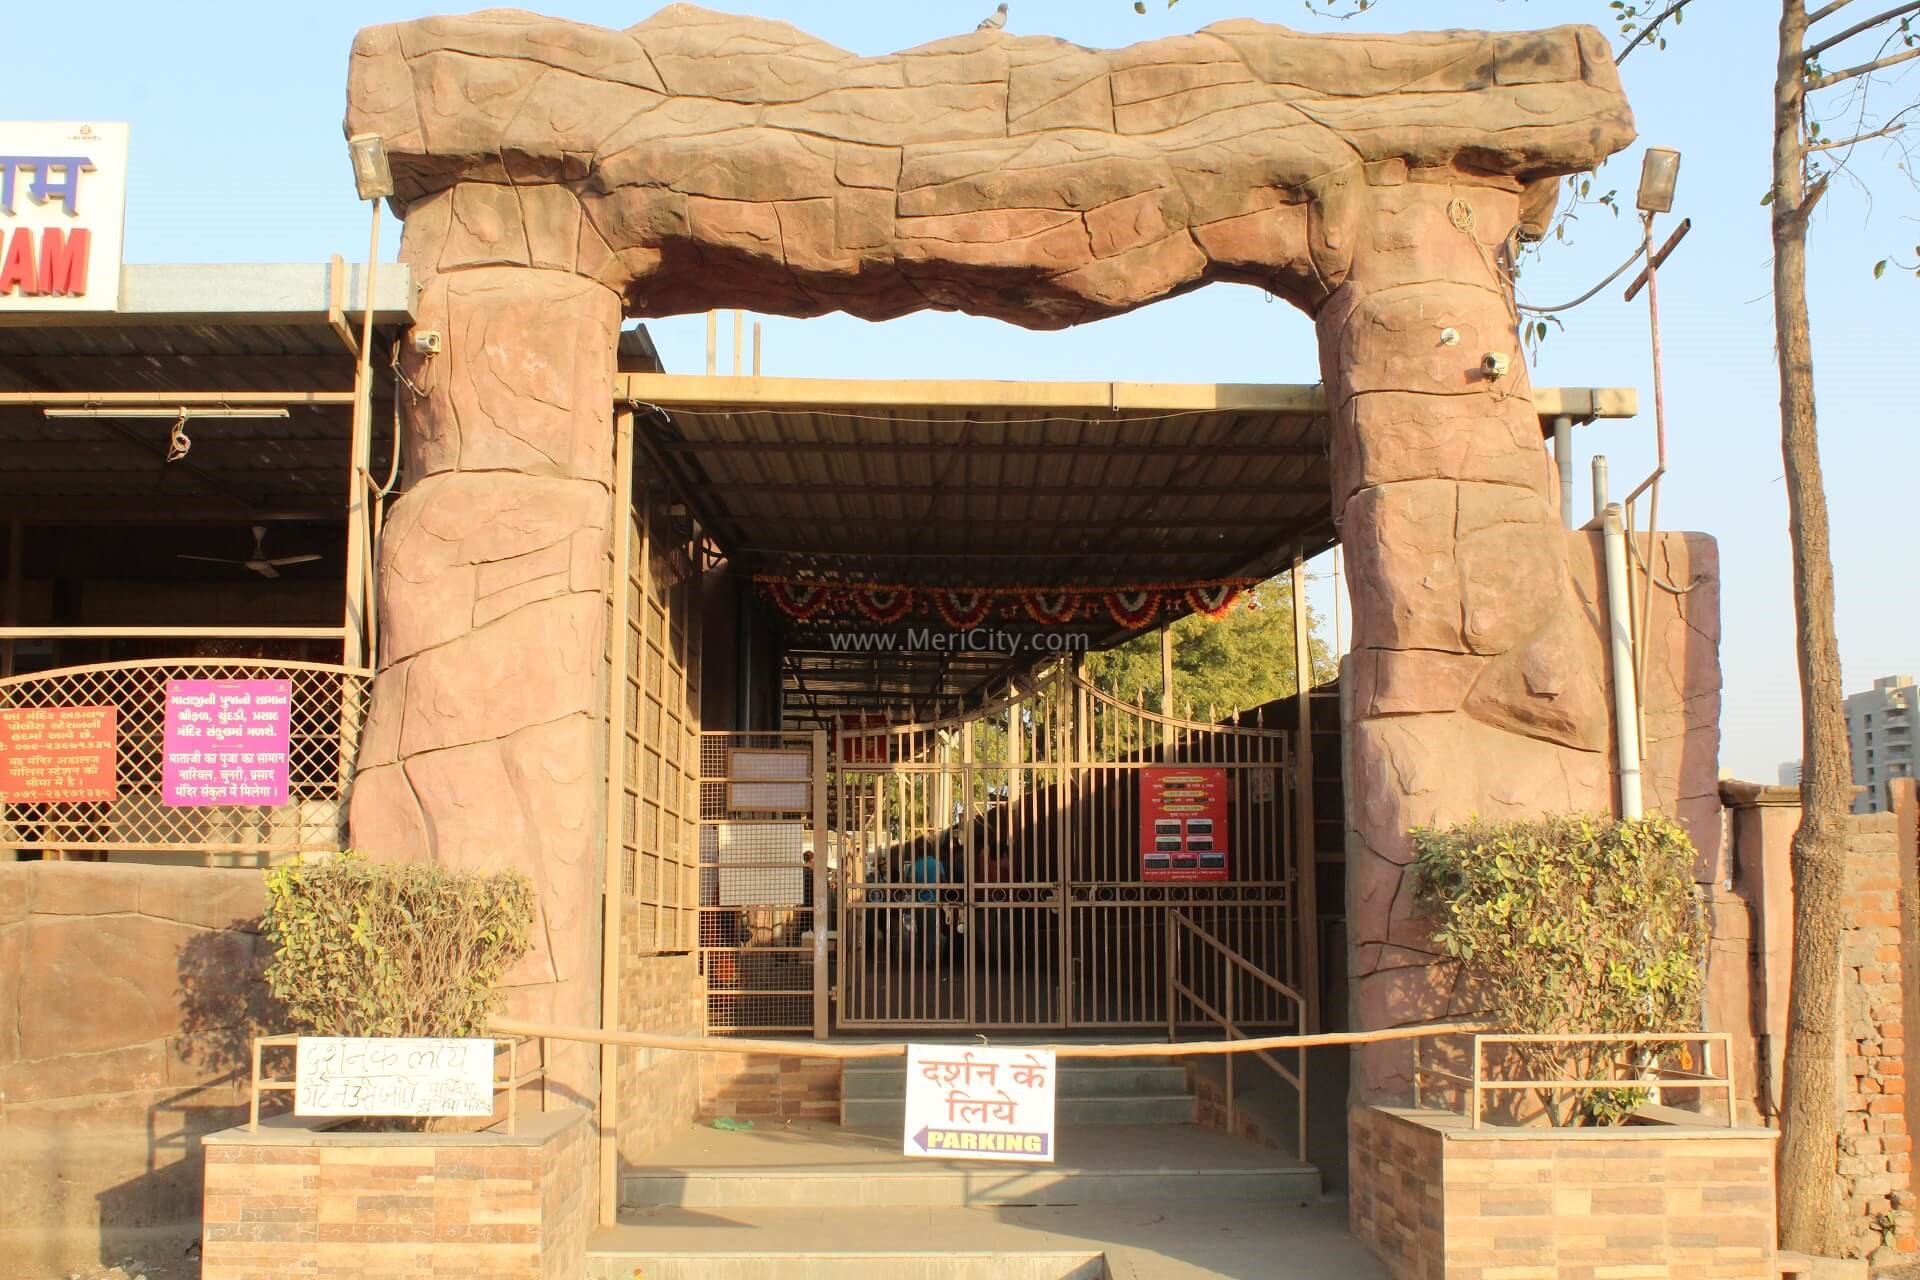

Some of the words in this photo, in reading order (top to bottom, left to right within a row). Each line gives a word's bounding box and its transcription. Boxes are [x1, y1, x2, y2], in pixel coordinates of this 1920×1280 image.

[0, 227, 91, 297] AM
[177, 724, 202, 737] મંદિર
[168, 749, 201, 764] माताजी
[256, 753, 286, 764] सामान
[249, 769, 275, 782] प्रसाद
[175, 783, 197, 798] मंदिर
[917, 1052, 1000, 1088] दर्शन
[1009, 1054, 1048, 1089] के
[944, 1090, 1019, 1125] लिये
[928, 1131, 1042, 1153] PARKING
